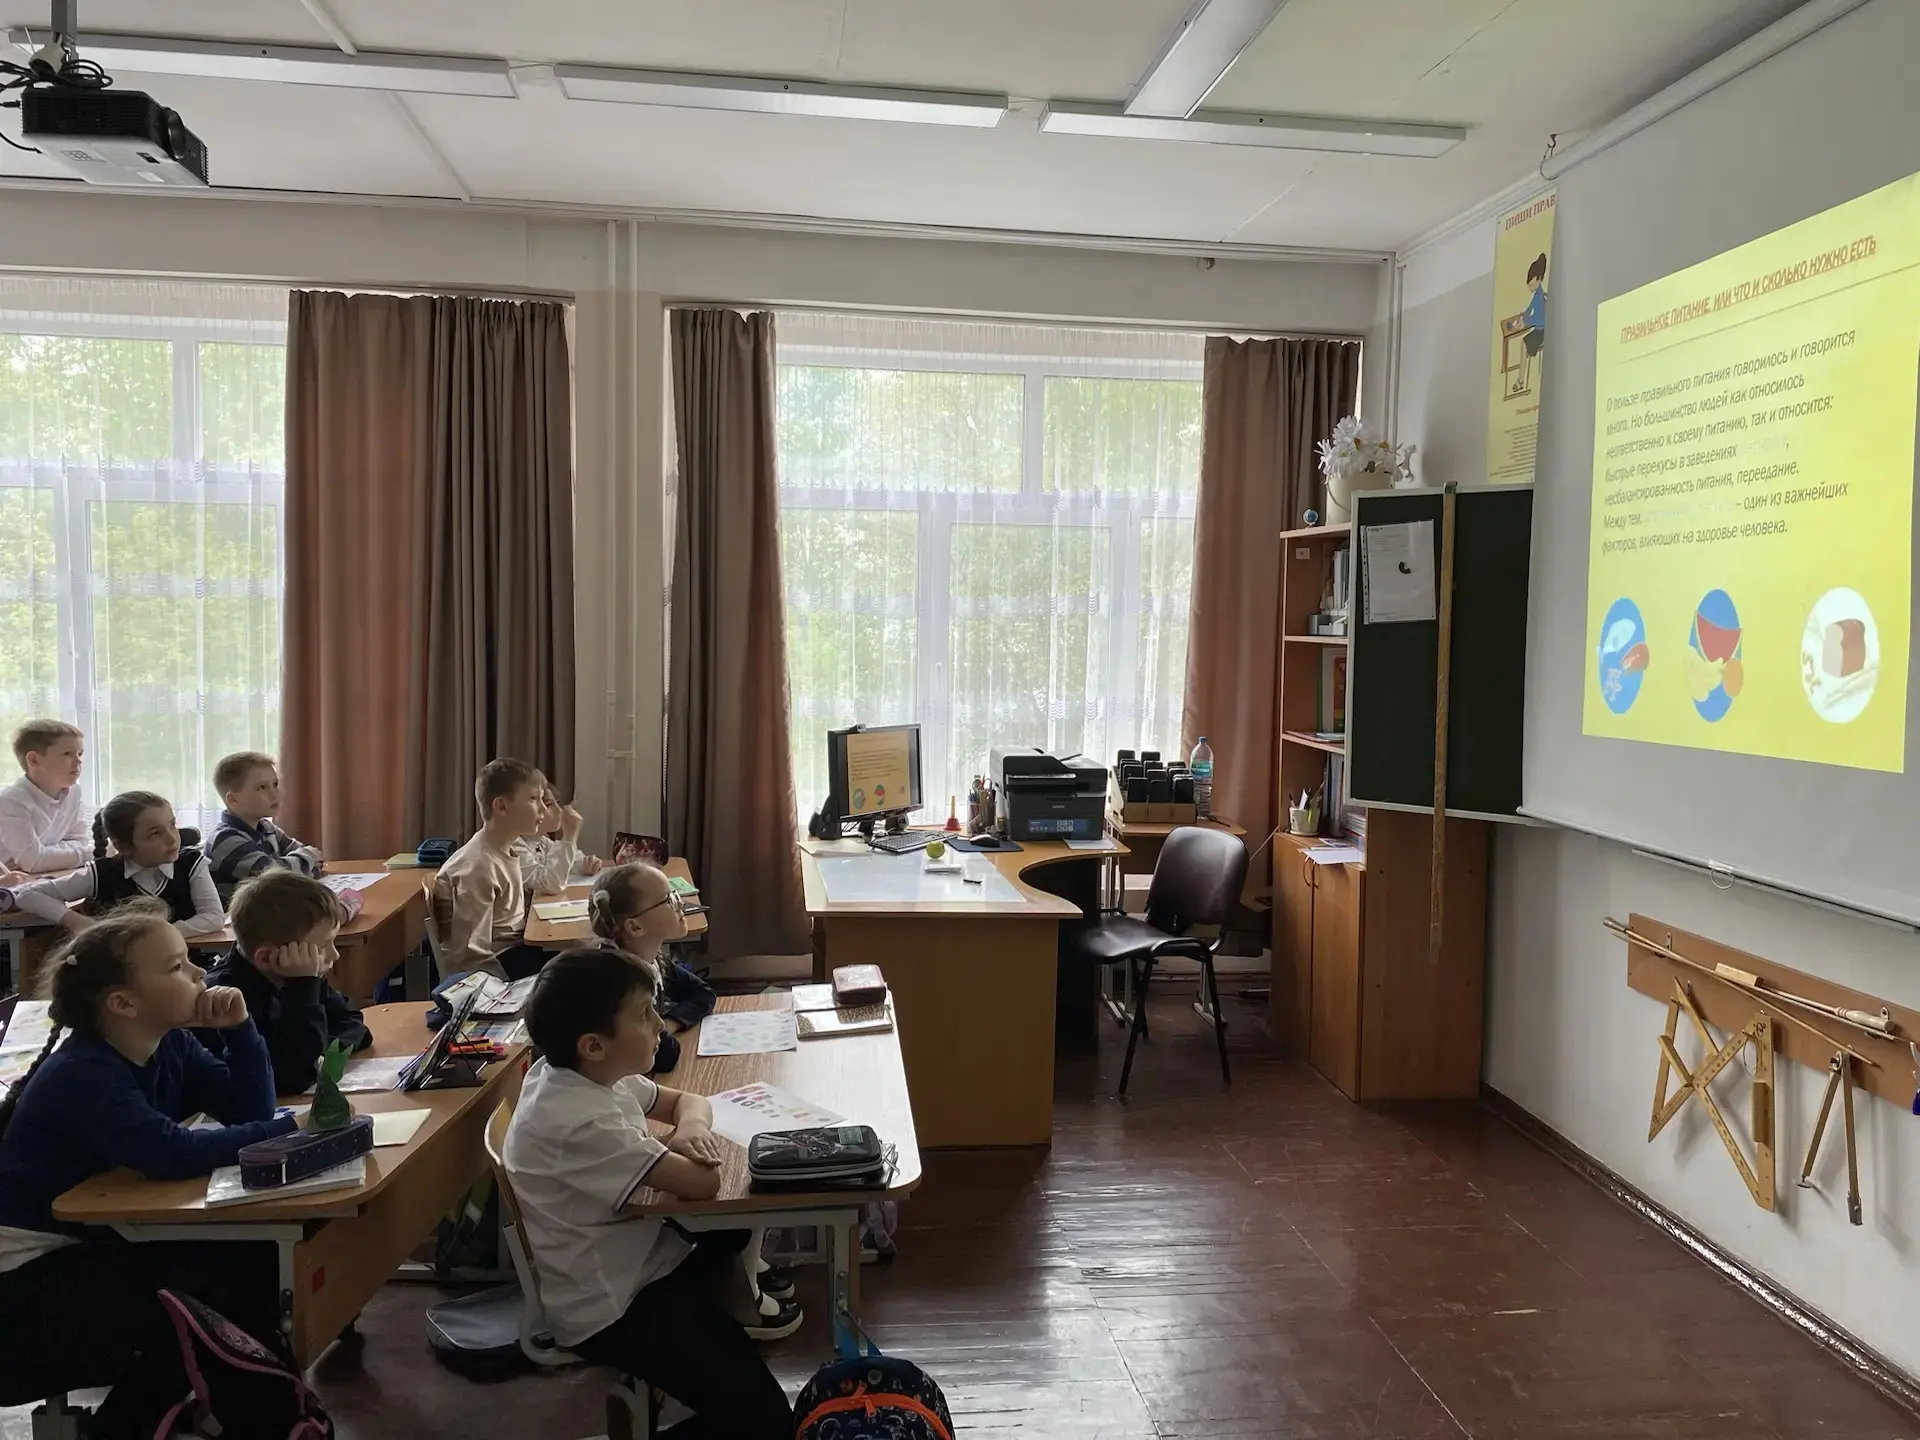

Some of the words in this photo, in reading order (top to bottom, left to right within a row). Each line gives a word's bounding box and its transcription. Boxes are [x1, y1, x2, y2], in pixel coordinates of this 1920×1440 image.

[1505, 208, 1532, 231] ПИШИ
[1620, 311, 1670, 343] ПРАВИЛЬНОЕ
[1713, 289, 1732, 312] ИЛИ
[1734, 281, 1751, 303] ЧТО
[1753, 276, 1761, 295] И
[1762, 260, 1808, 293] СКОЛЬКО
[1809, 245, 1849, 276] НУЖНО
[1850, 234, 1877, 261] ЕСТЬ
[1613, 393, 1639, 410] пользе
[1641, 377, 1692, 406] правильного
[1693, 366, 1731, 388] питания
[1733, 350, 1788, 378] говорилось
[1791, 347, 1798, 361] и
[1800, 330, 1856, 358] говорится
[1631, 415, 1643, 428] Но
[1644, 403, 1697, 427] большинство
[1698, 390, 1729, 412] людей
[1730, 388, 1748, 405] как
[1749, 374, 1805, 400] относилось
[1666, 434, 1672, 446] к
[1673, 426, 1704, 444] своему
[1705, 416, 1748, 436] питанию,
[1752, 410, 1767, 427] так
[1769, 408, 1776, 422] и
[1778, 395, 1835, 421] относится:
[1605, 465, 1637, 483] быстрые
[1637, 457, 1678, 478] перекусы
[1679, 456, 1686, 469] в
[1687, 445, 1738, 468] заведениях
[1696, 472, 1734, 491] питания,
[1737, 460, 1800, 486] переедание.
[1604, 514, 1627, 531] Между
[1743, 493, 1768, 511] один
[1770, 491, 1782, 507] из
[1784, 481, 1849, 505] важнейших
[1640, 532, 1681, 549] влияющих
[1683, 531, 1694, 543] на
[1696, 525, 1738, 545] здоровье
[1740, 519, 1788, 537] человека.
